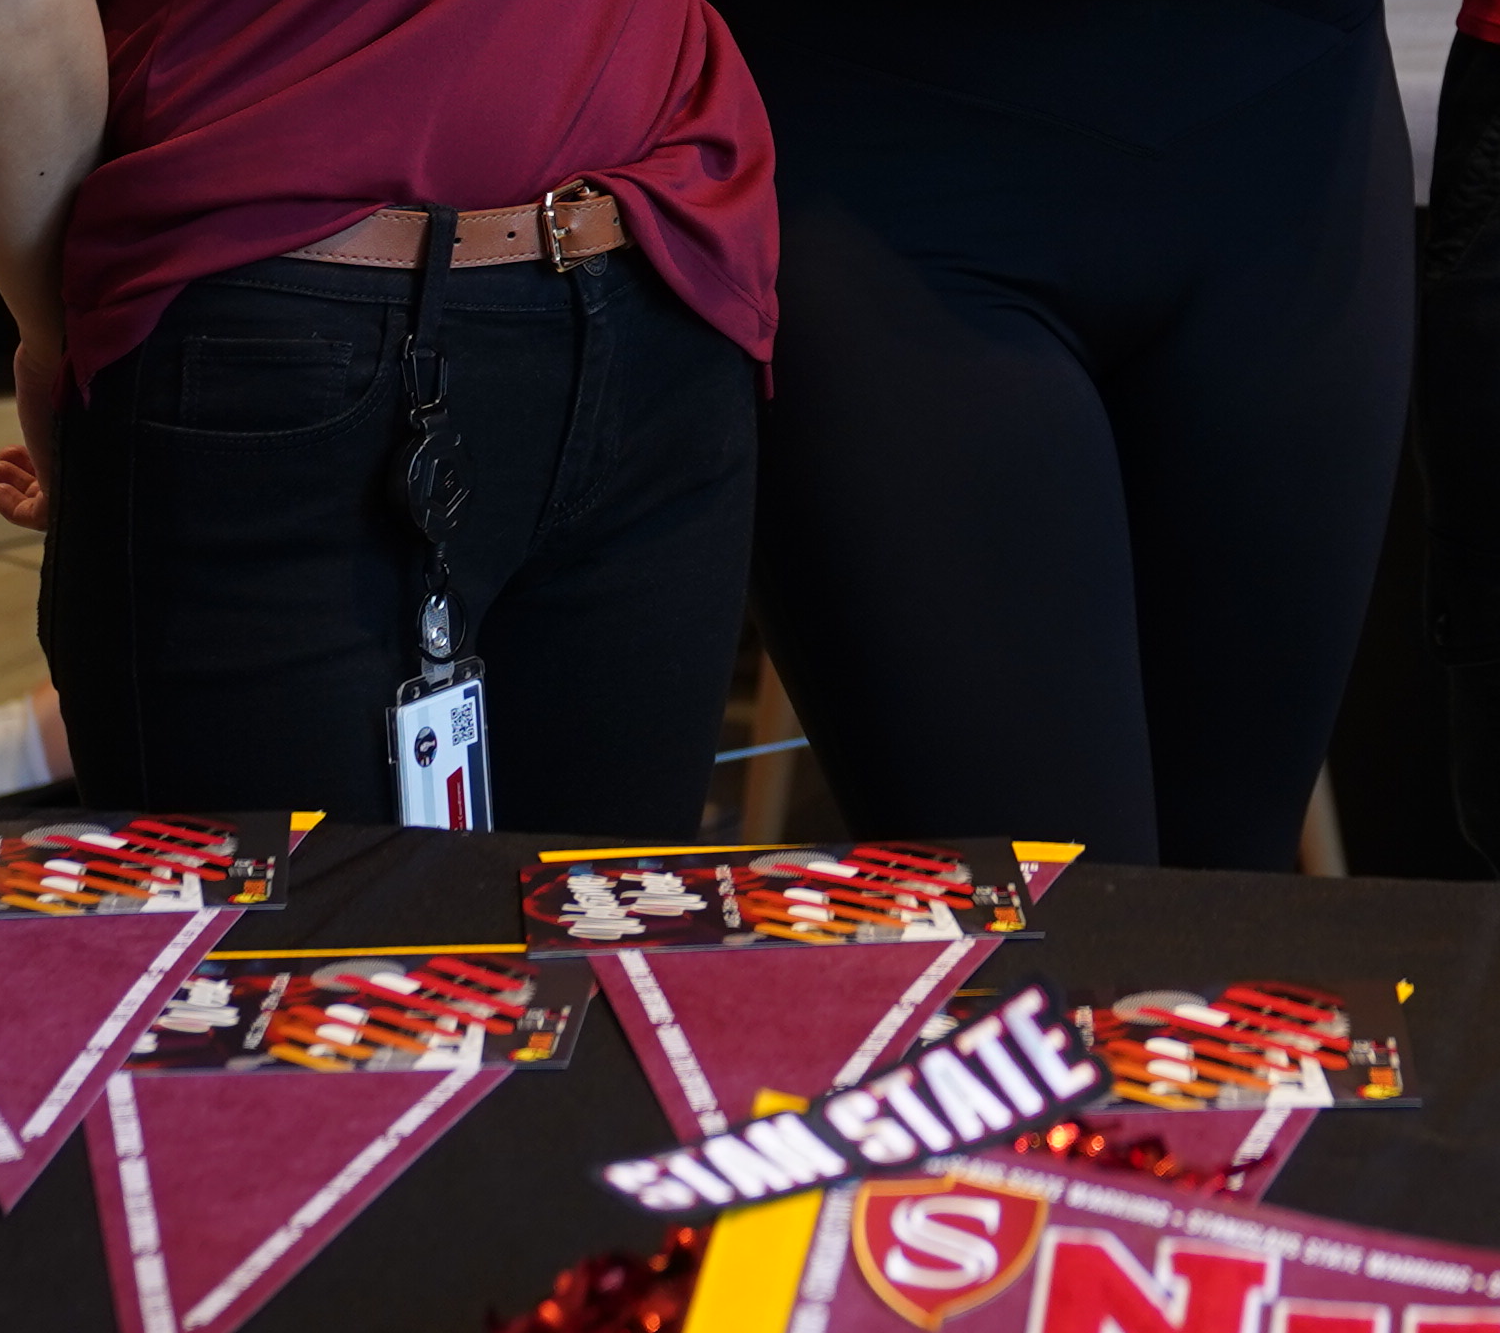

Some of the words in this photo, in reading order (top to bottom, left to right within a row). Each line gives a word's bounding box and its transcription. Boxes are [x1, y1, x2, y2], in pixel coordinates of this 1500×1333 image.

[604, 1110, 849, 1211] STAN
[824, 985, 1098, 1165] STATE
[884, 1194, 1002, 1291] S
